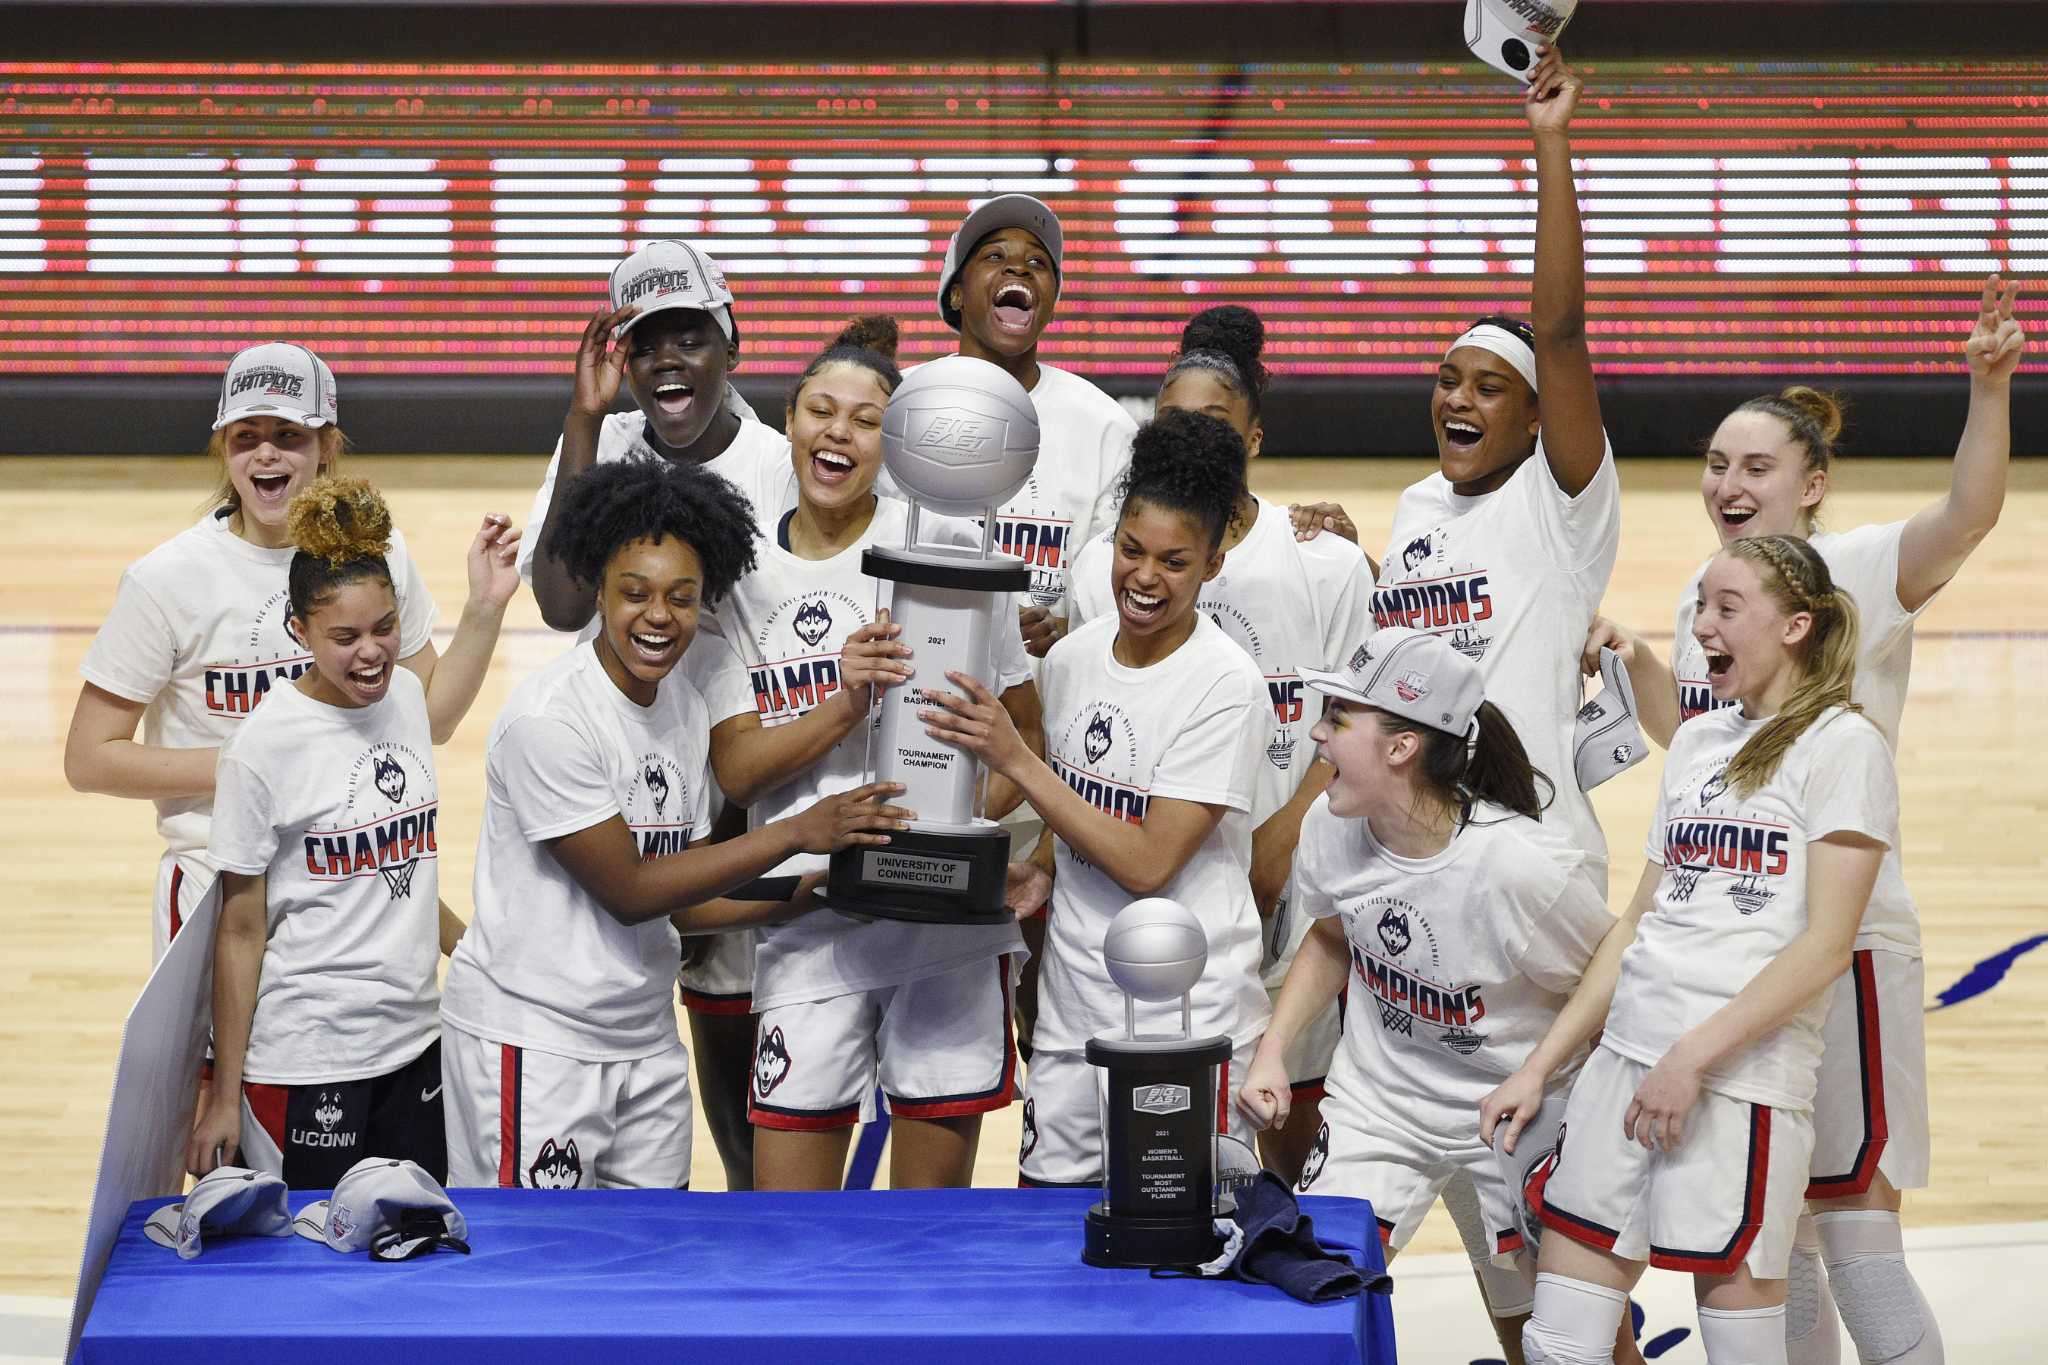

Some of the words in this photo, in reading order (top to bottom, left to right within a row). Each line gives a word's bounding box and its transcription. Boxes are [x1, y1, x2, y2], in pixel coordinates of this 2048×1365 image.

[86, 157, 455, 273] BIG
[492, 157, 1077, 273] EAST
[231, 370, 305, 397] CHAMPIONS
[919, 430, 993, 450] EAST
[1369, 576, 1493, 631] AMPIONS
[927, 636, 946, 645] 2021
[897, 748, 955, 762] TOURNAMENT
[903, 758, 948, 770] CHAMPION
[877, 857, 940, 873] UNIVERSITY
[941, 863, 957, 873] OF
[877, 868, 954, 884] CONNECTICUT
[1144, 1095, 1183, 1104] EAST
[1150, 1087, 1176, 1097] BIG
[291, 1128, 356, 1148] UCONN
